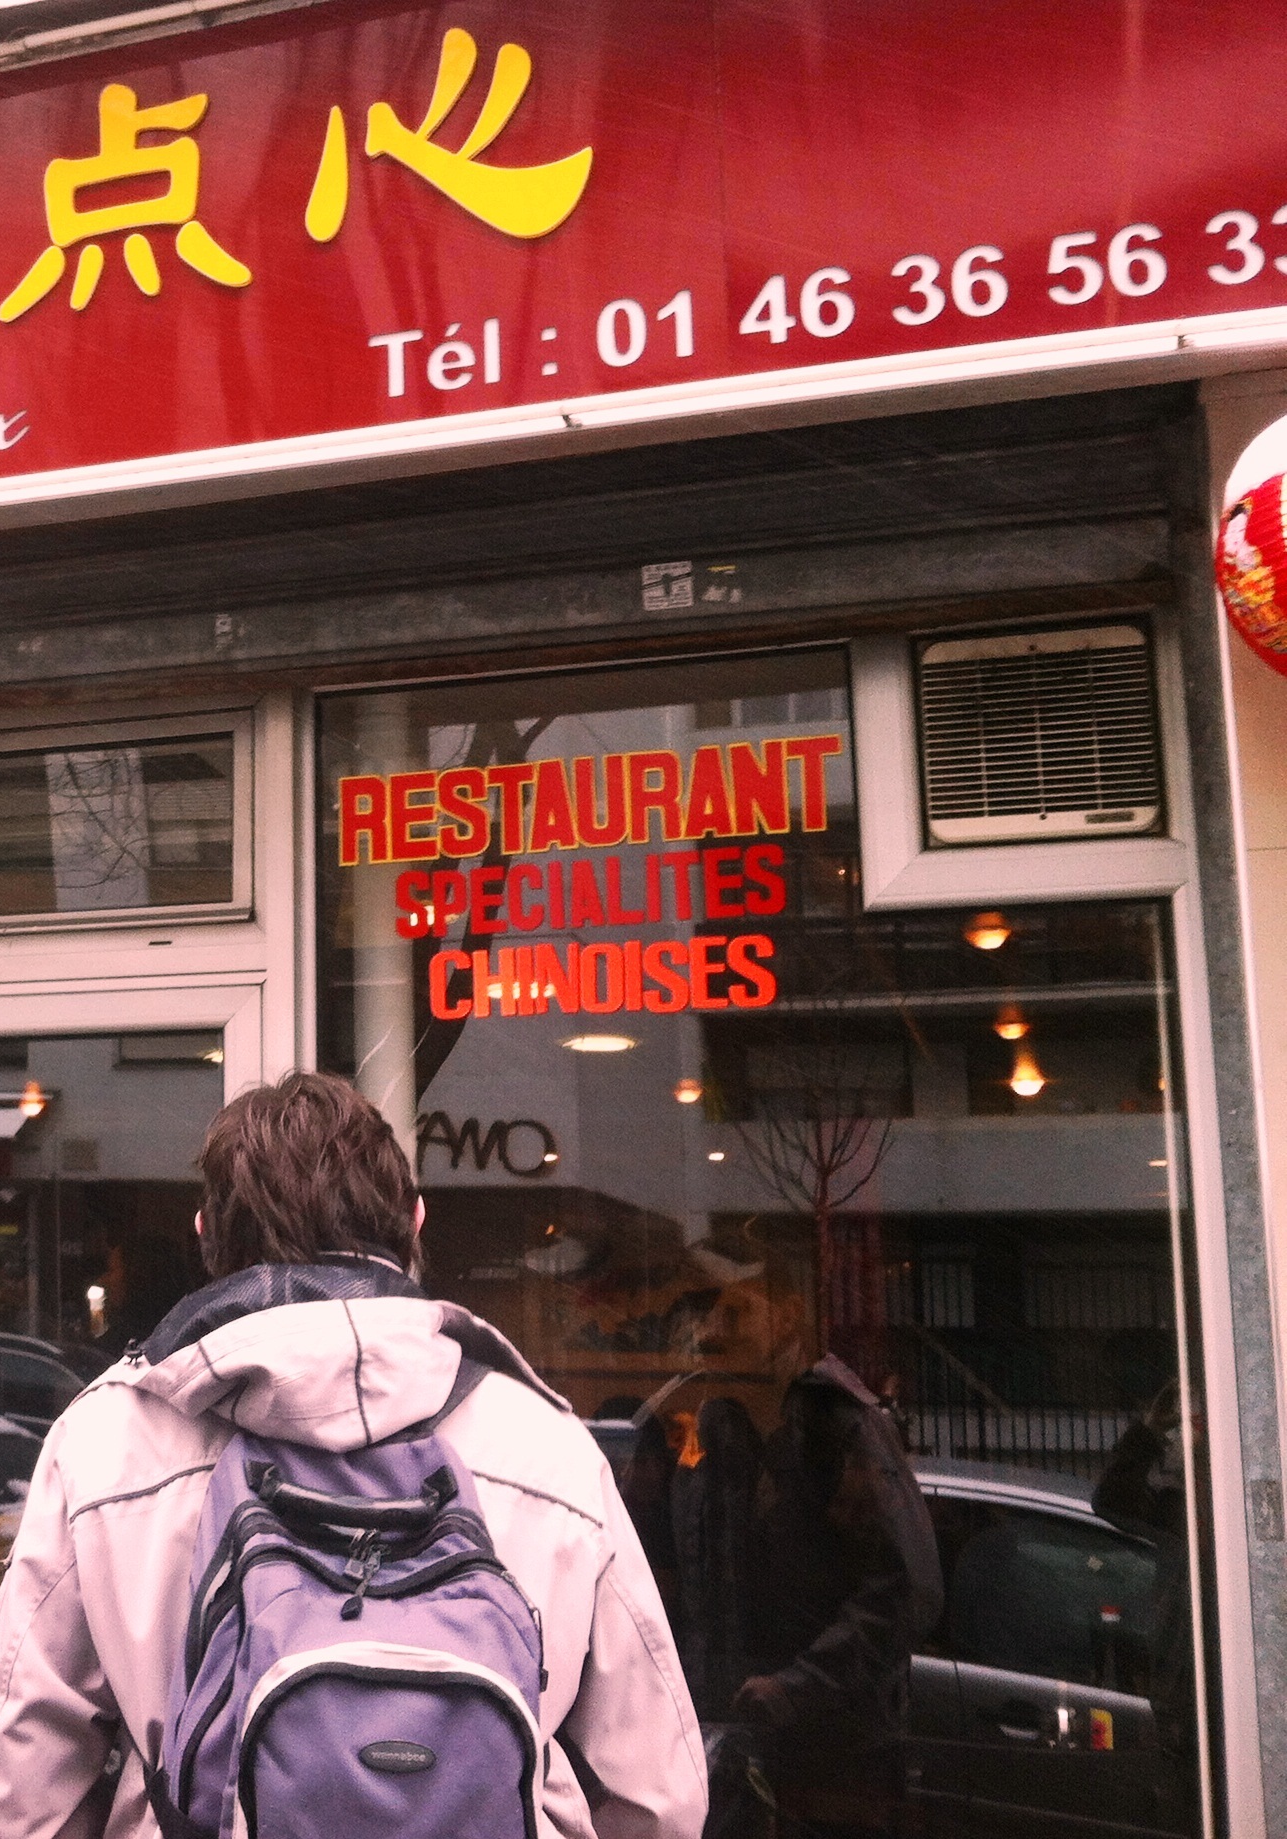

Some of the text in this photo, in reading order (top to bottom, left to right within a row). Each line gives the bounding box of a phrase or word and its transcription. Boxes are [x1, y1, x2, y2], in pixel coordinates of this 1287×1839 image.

[368, 318, 502, 398] Tél
[596, 290, 694, 367] 01
[739, 267, 855, 344] 46
[891, 245, 1009, 326] 36
[1047, 224, 1167, 305] 56
[1205, 204, 1287, 285] 3
[337, 733, 844, 867] RESTAURANT
[393, 844, 787, 940] SPECIALITES
[427, 933, 777, 1021] CHINOISES
